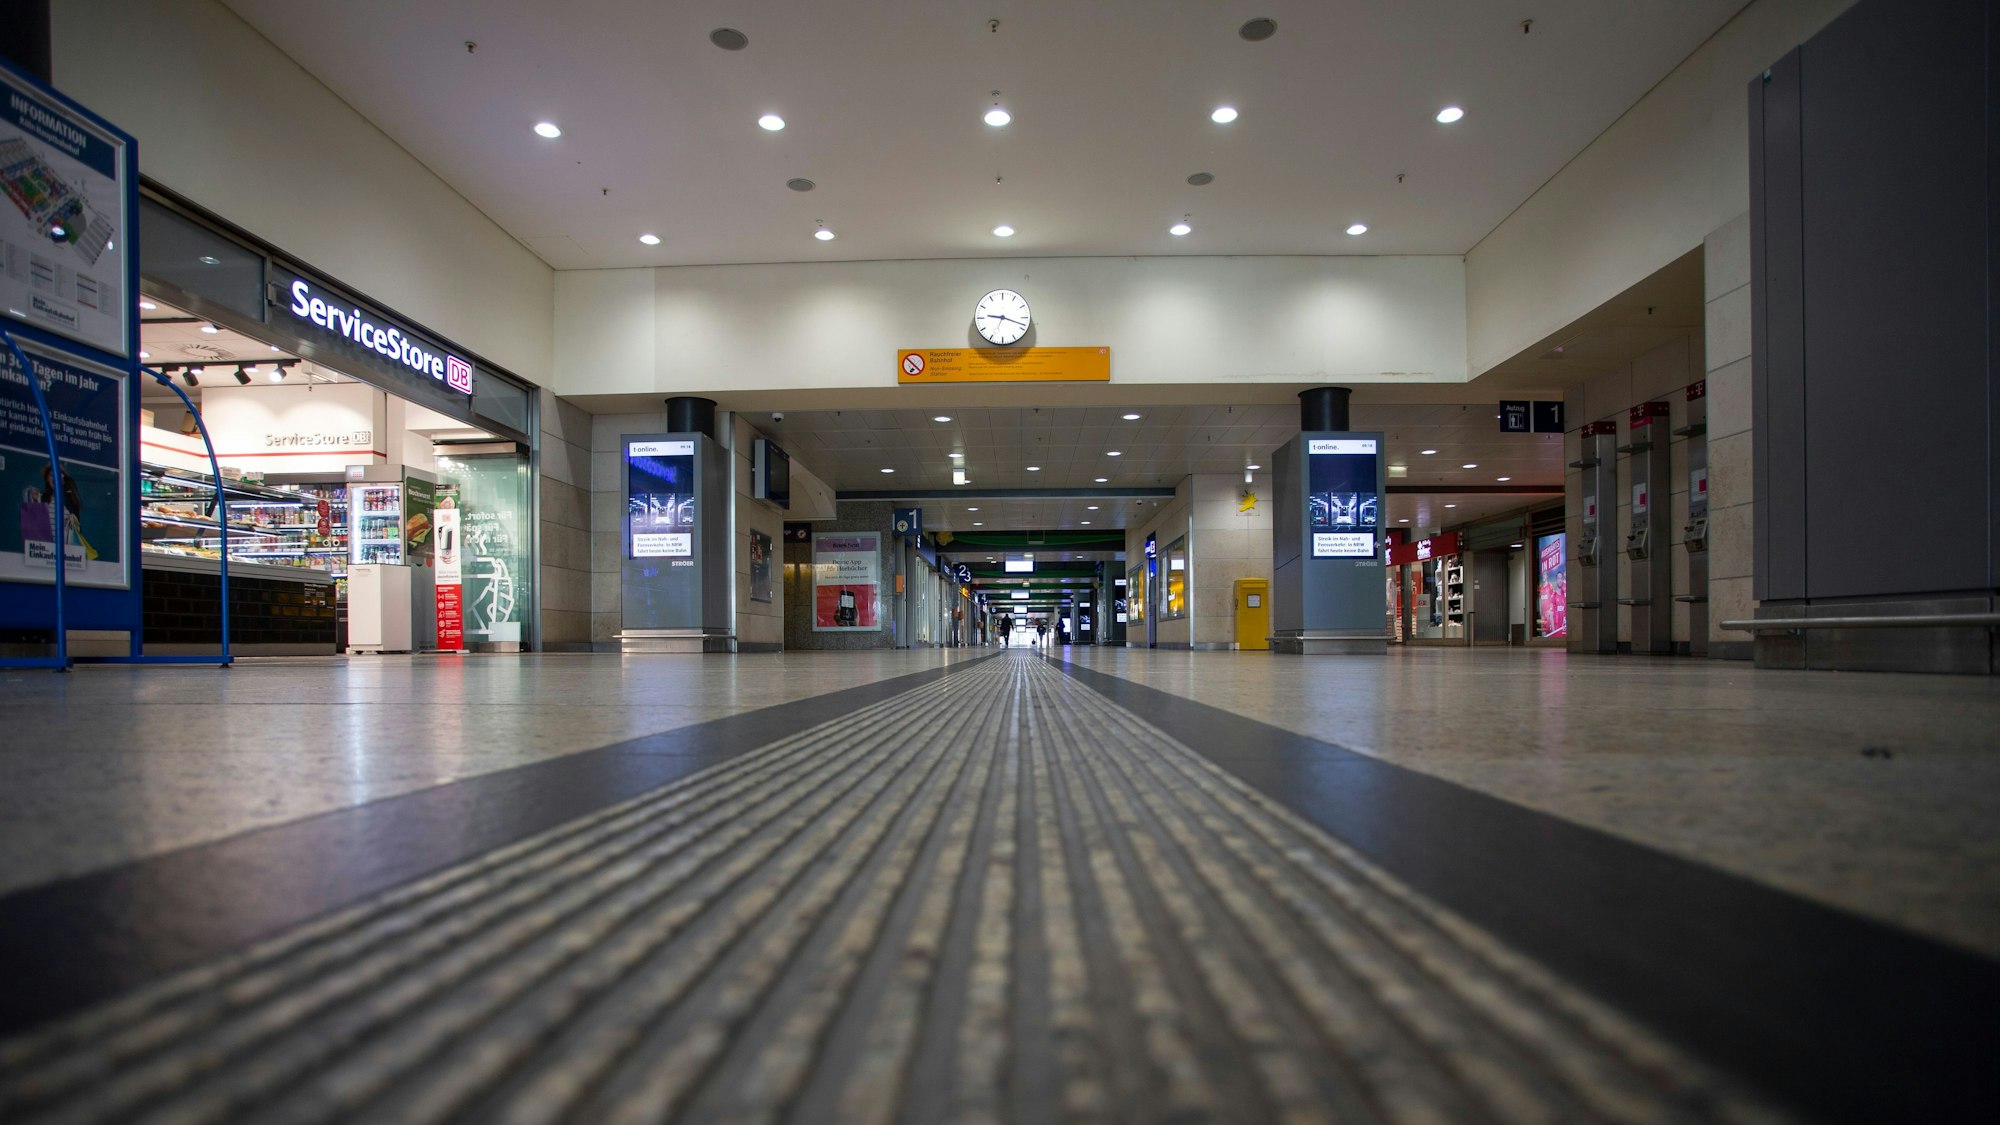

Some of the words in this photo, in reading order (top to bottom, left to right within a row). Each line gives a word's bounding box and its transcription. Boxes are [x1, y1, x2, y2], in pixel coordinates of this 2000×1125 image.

[11, 92, 87, 149] INFORMATION
[291, 280, 444, 380] ServiceStore
[450, 360, 469, 388] DB
[32, 360, 63, 382] Tagen
[66, 370, 78, 386] im
[80, 375, 100, 392] Jahr
[1506, 404, 1525, 412] Aufzug
[1550, 404, 1559, 424] 1
[8, 411, 28, 422] kann
[29, 414, 40, 425] ich
[62, 424, 74, 436] Tag
[265, 433, 350, 446] ServiceStore
[908, 509, 917, 529] 1
[959, 564, 966, 576] 2
[1548, 552, 1559, 568] ROT
[964, 571, 972, 582] 3
